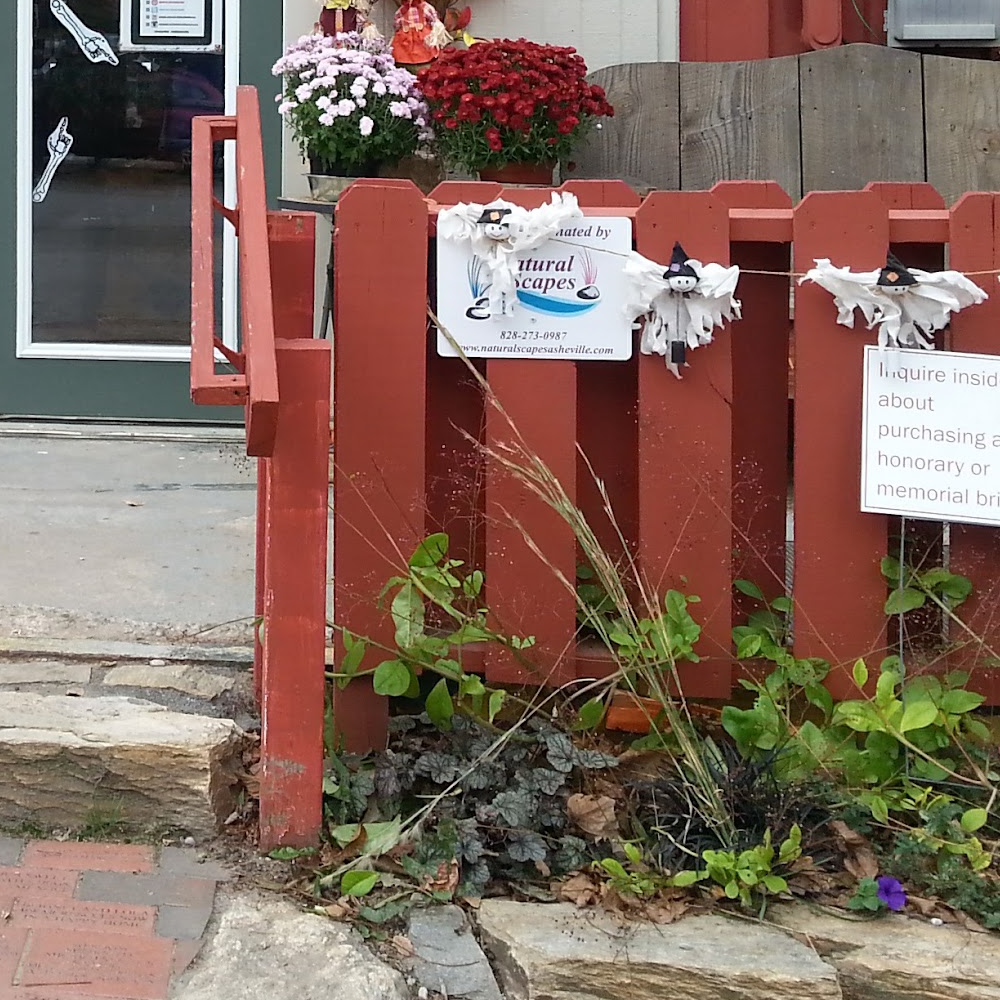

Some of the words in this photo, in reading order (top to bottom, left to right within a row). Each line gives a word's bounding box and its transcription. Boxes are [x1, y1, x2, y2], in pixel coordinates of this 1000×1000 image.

[596, 226, 611, 240] by
[500, 331, 568, 340] 828-273-0987
[953, 368, 1000, 387] insid
[878, 392, 934, 411] about
[878, 424, 986, 450] purchasing
[878, 450, 964, 476] honorary
[971, 463, 990, 476] or
[877, 483, 969, 504] memorial
